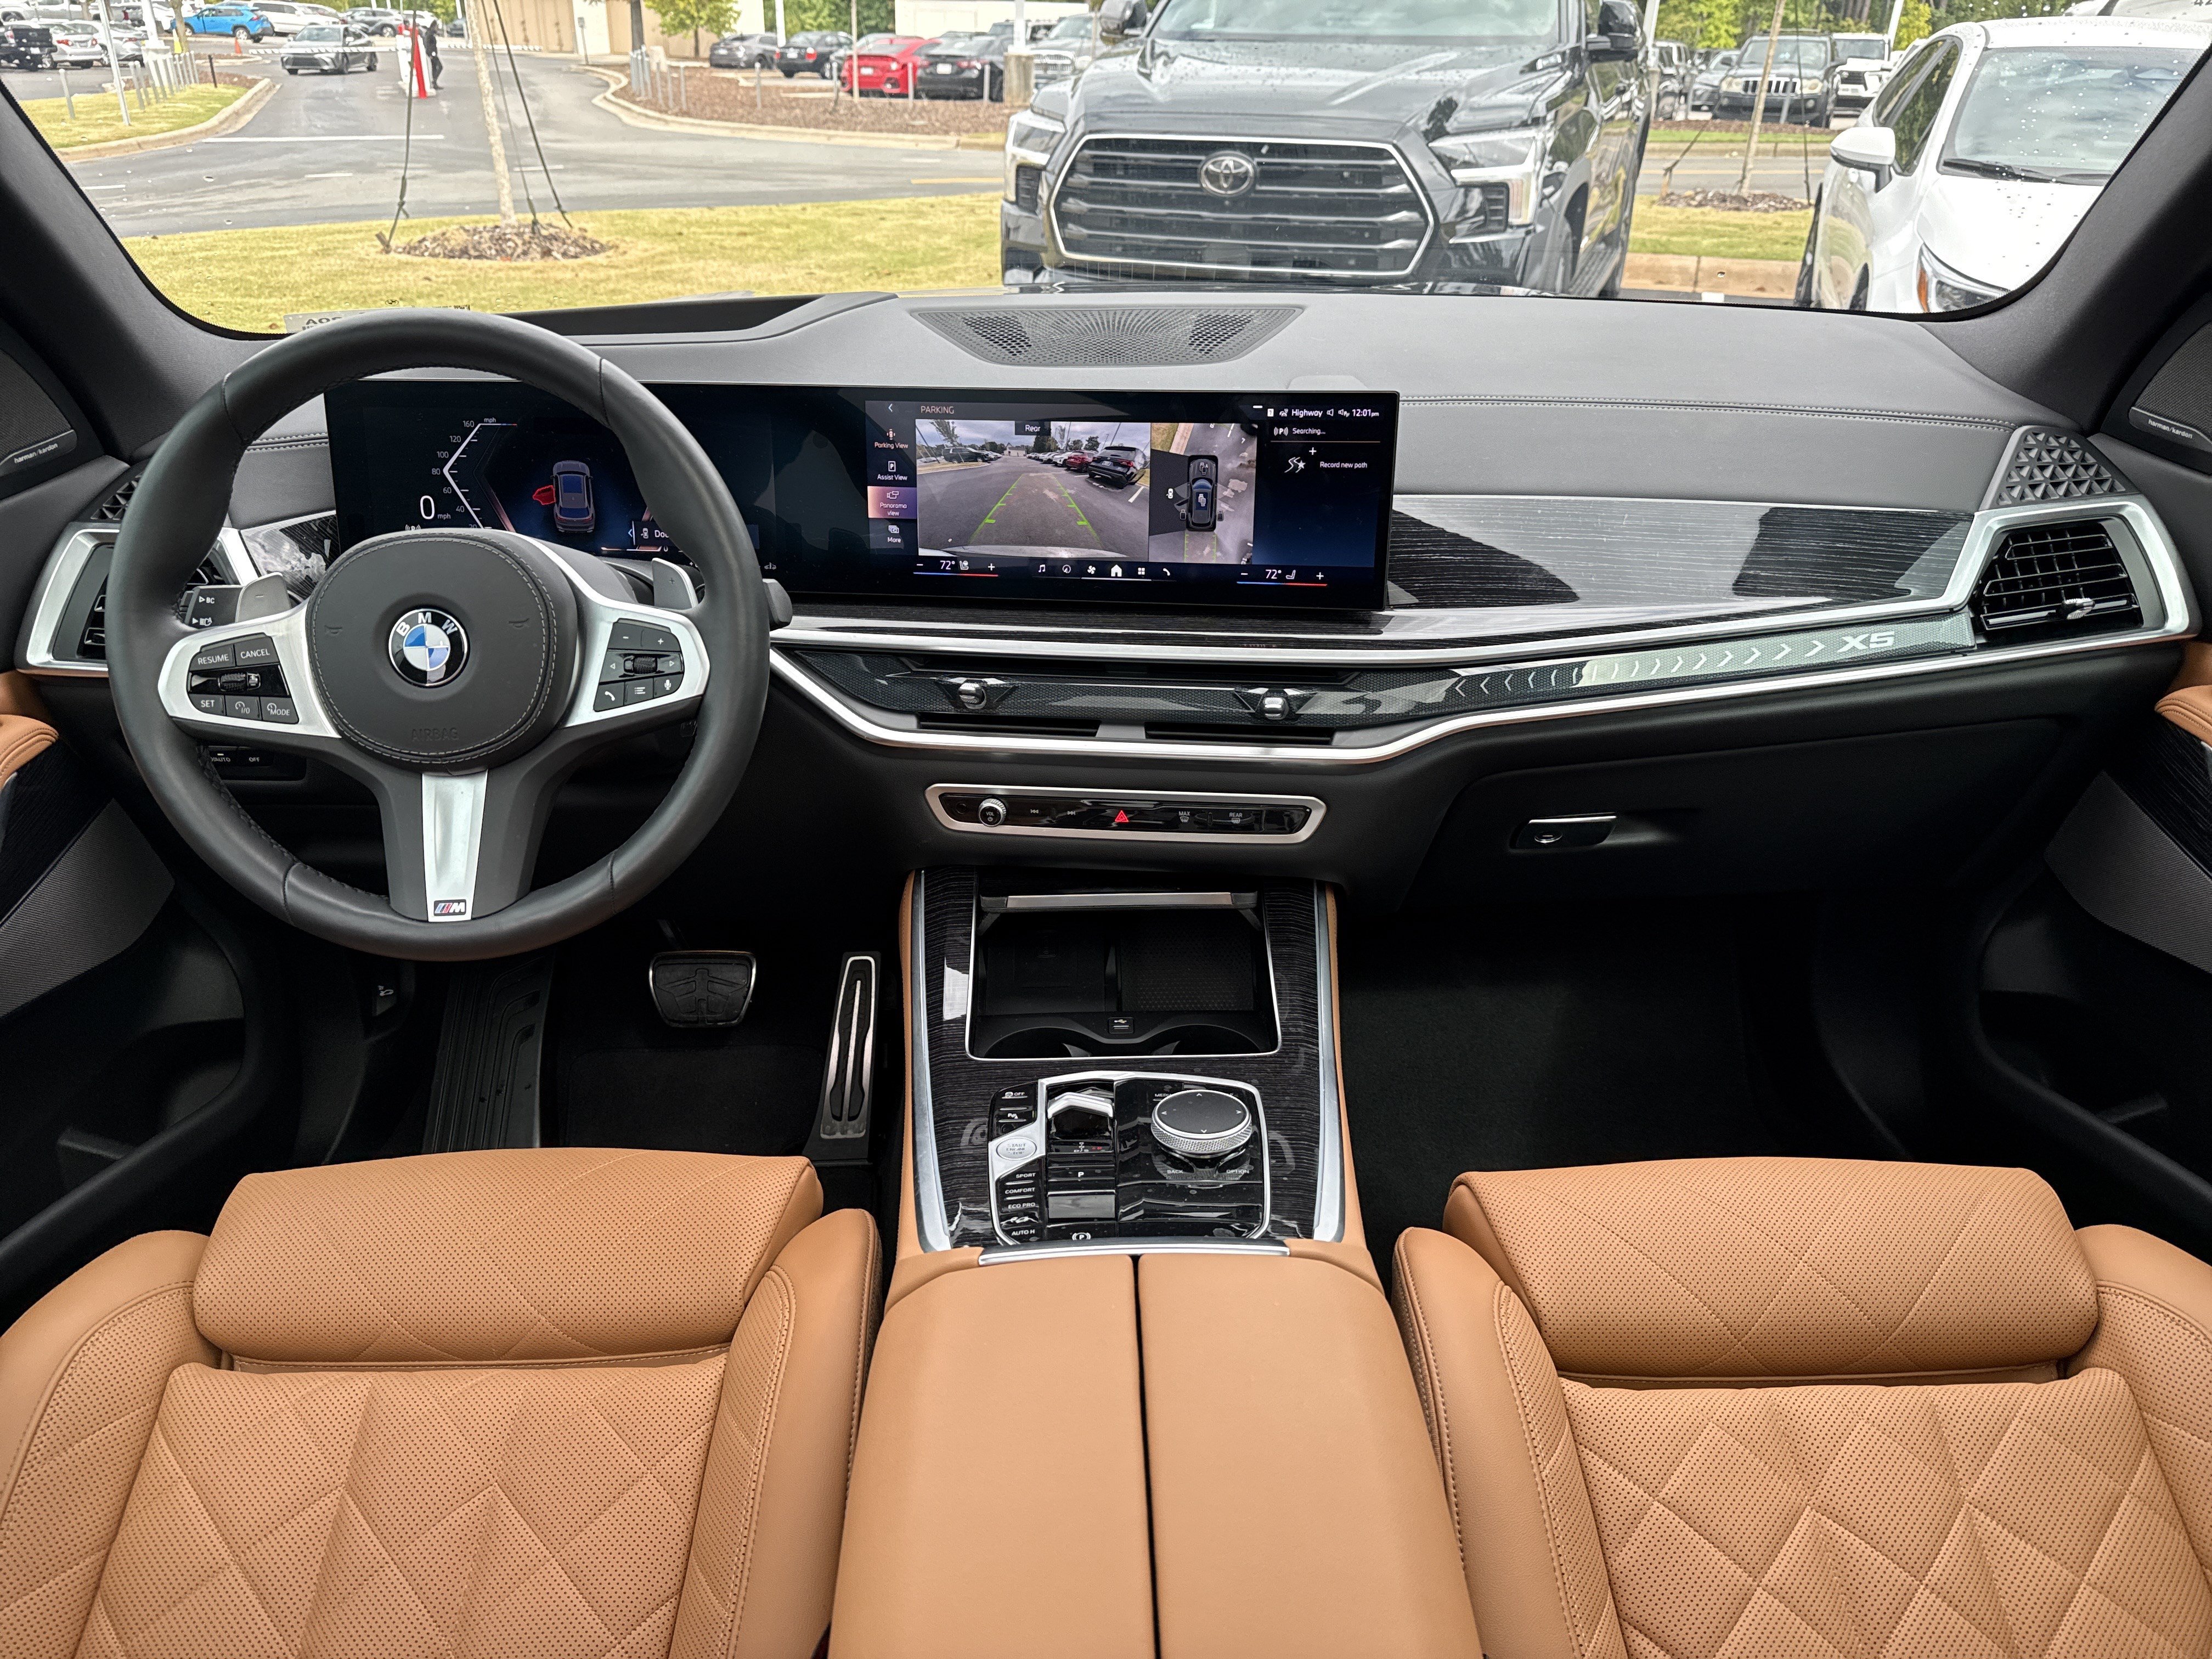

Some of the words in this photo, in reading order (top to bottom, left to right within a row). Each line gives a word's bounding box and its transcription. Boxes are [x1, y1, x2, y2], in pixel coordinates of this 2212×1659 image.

[921, 406, 955, 414] PARKING
[1291, 409, 1323, 418] Highway
[2148, 419, 2193, 439] harman/kardon
[874, 442, 894, 450] Parking
[420, 495, 435, 520] 0
[396, 612, 459, 636] BMW
[1837, 631, 1895, 653] X5
[198, 653, 229, 665] RESUME
[240, 648, 270, 659] CANCEL
[201, 699, 215, 708] SET
[411, 727, 459, 742] AIRBAG
